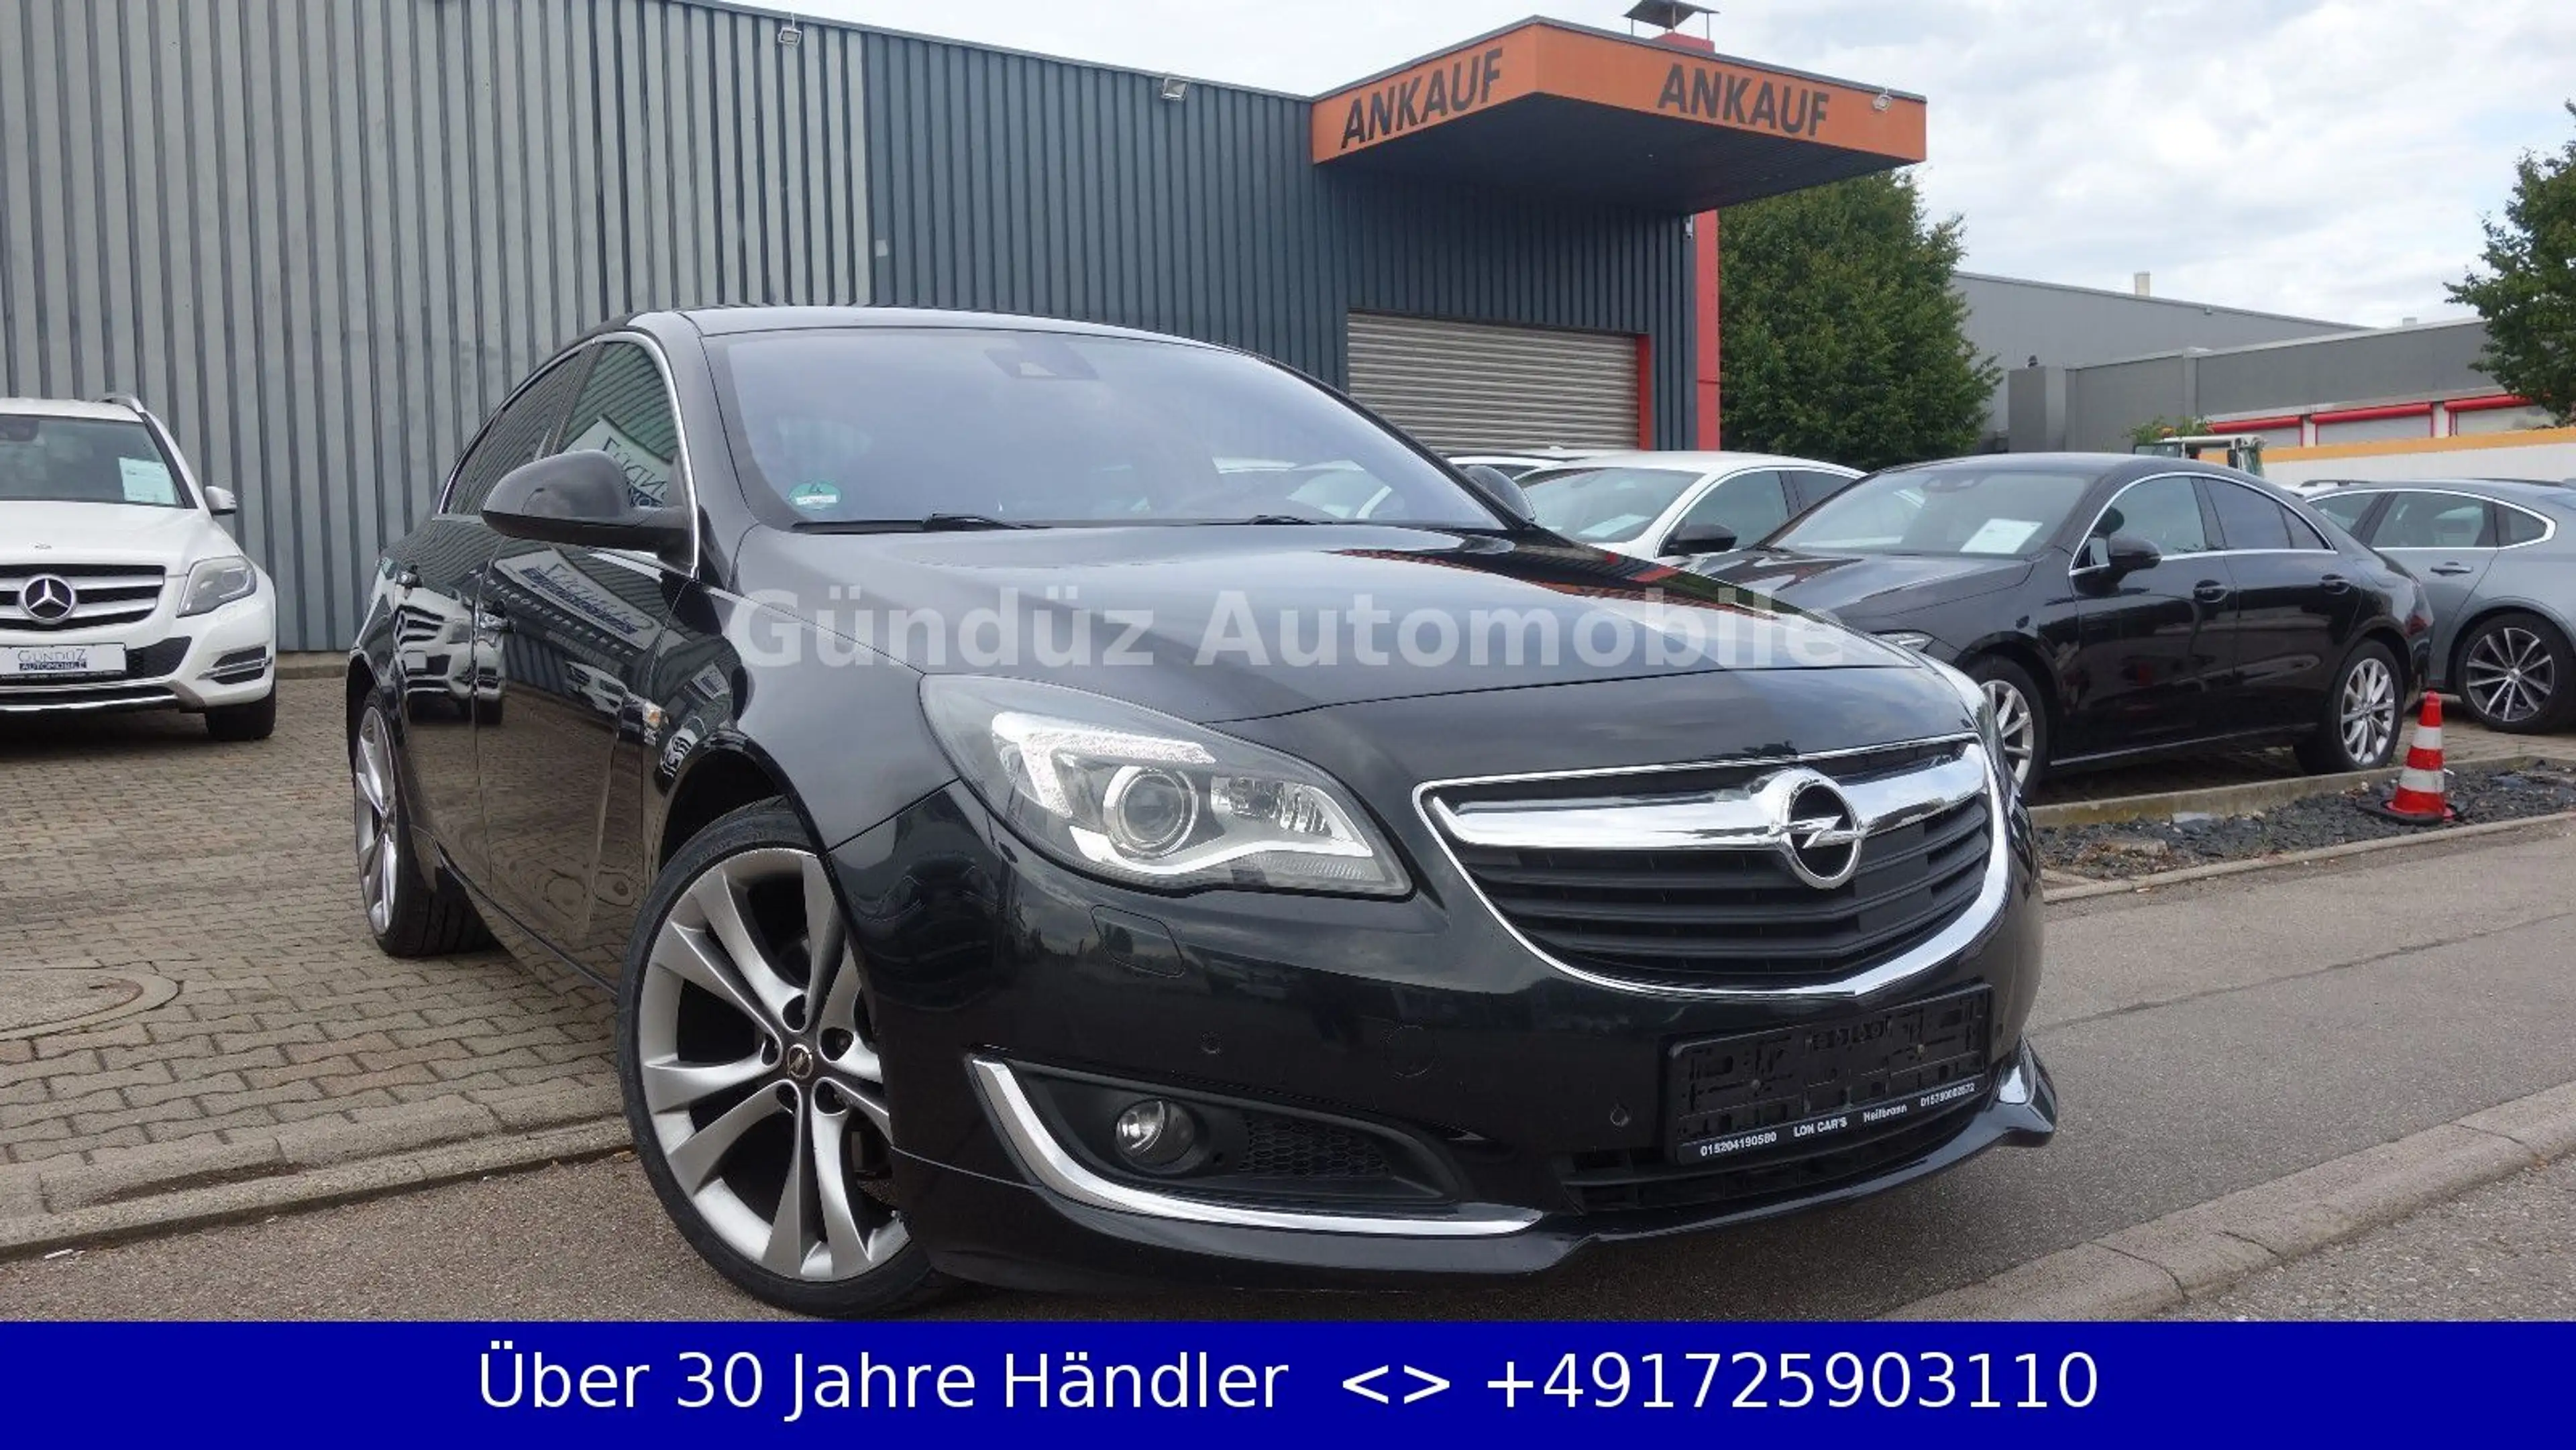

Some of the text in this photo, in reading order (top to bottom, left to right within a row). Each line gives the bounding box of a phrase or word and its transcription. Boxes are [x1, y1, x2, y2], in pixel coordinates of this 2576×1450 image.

[1340, 48, 1503, 150] ANKAUF
[1657, 63, 1830, 136] ANKAUF
[1863, 1104, 1907, 1122] Heilbronn
